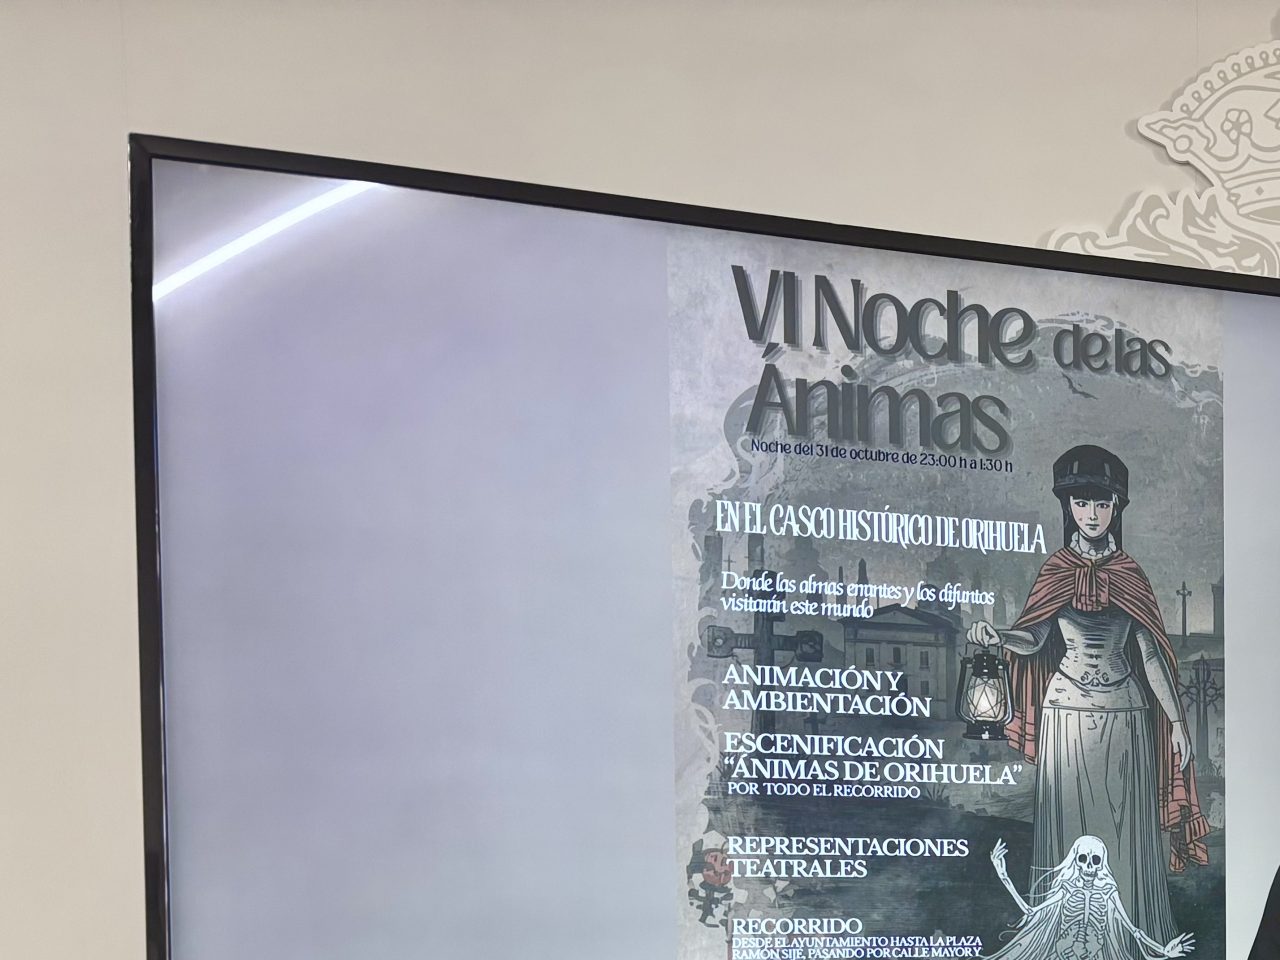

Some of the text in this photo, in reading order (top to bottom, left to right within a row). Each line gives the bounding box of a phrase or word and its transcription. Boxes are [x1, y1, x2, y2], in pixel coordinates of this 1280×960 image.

[731, 265, 1172, 378] VI Noche de las
[745, 342, 1011, 453] Ánimas
[751, 438, 1013, 473] Noche del 31 de octubre de 23:00 h a 1:30 h
[716, 500, 1047, 554] EN EL CASCO HISTÓRICO DE ORIHUELA
[721, 571, 995, 610] Donde las almas errantes y los difuntos
[720, 593, 874, 618] visitarán este mundo
[722, 664, 903, 691] ANIMACIÓN Y
[722, 690, 932, 717] AMBIENTACIÓN
[724, 732, 945, 759] ESCENIFICACIÓN
[843, 761, 880, 782] DE
[728, 782, 921, 799] POR TODO EL RECORRIDO
[727, 836, 969, 857] REPRESENTACIONES
[727, 859, 867, 878] TEATRALES
[732, 918, 863, 935] RECORRIDO
[732, 936, 982, 948] DESDE EL AYUNTAMIENTO HASTA LA PLAZA
[732, 947, 780, 960] RAMÓN
[808, 948, 864, 959] PASANDO
[867, 947, 891, 958] POR
[892, 947, 929, 958] CALLE
[931, 947, 972, 957] MAYOR
[973, 947, 982, 957] Y
